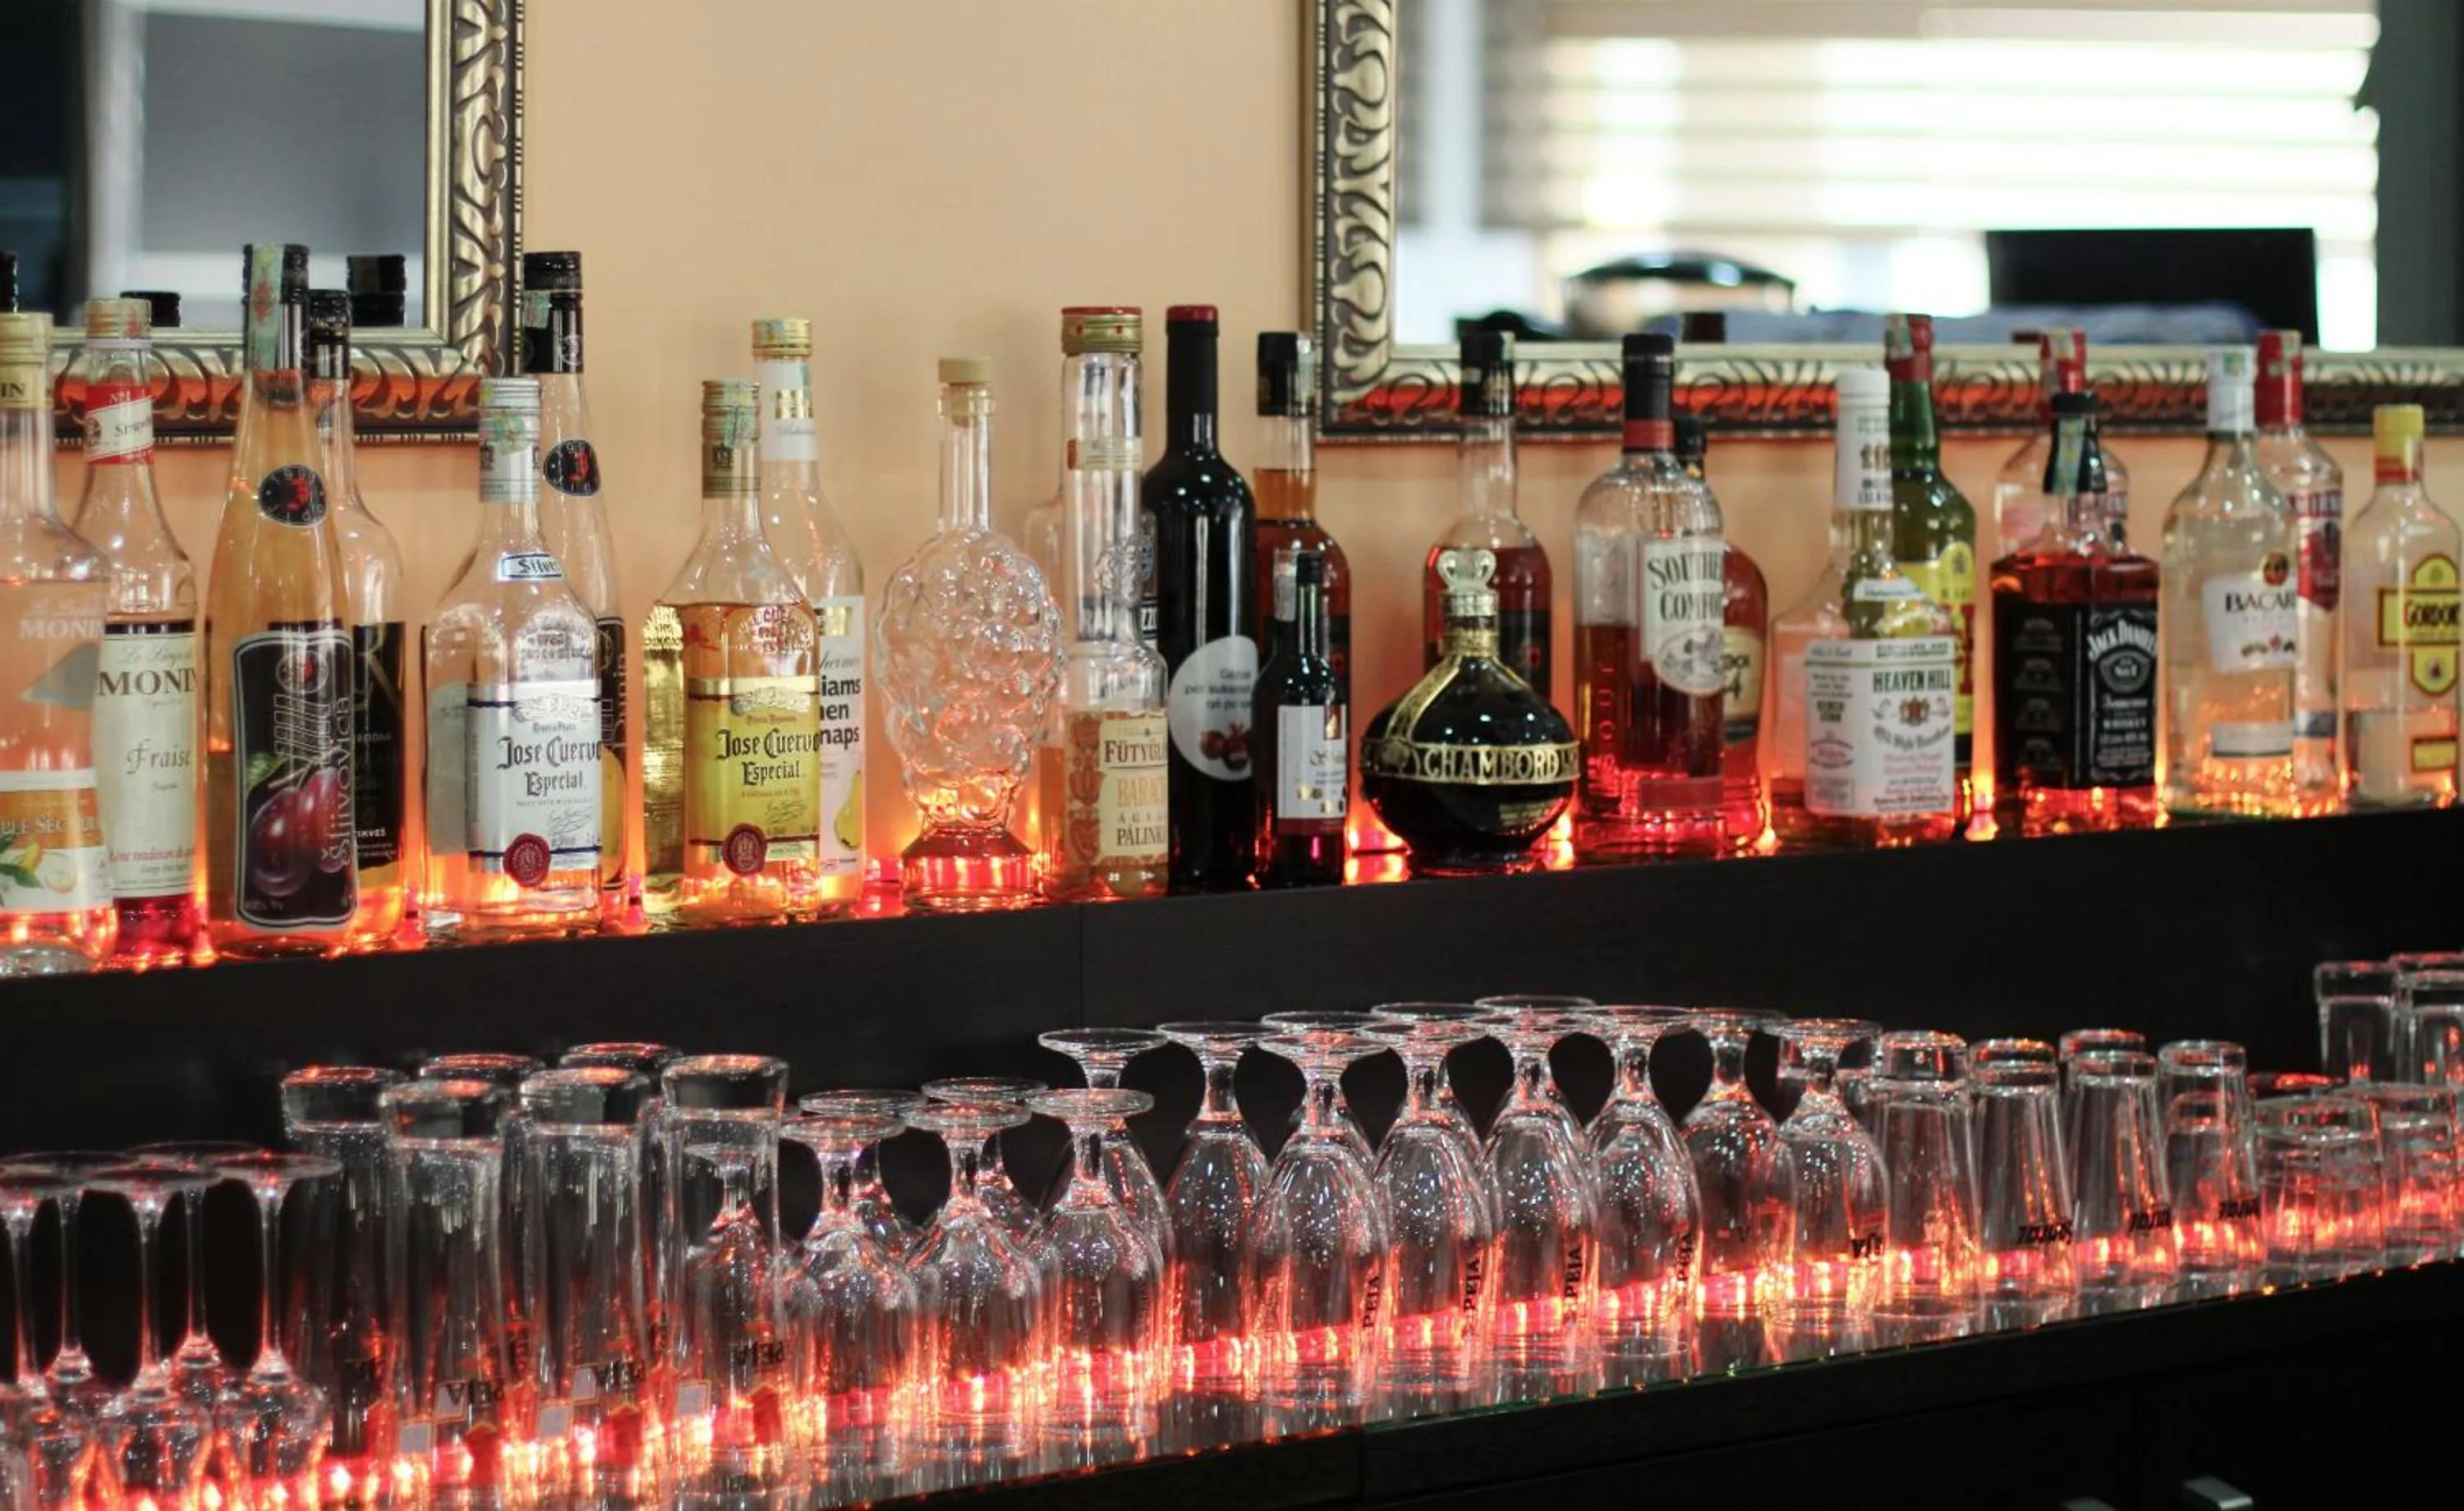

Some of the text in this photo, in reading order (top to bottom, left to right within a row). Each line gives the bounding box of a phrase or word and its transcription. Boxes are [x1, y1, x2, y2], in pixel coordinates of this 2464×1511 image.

[1873, 669, 1924, 694] HEAVEN
[1927, 668, 1951, 691] HILL
[496, 736, 543, 770] Jose
[716, 728, 760, 760] Jose
[742, 760, 799, 787] Especial
[1423, 748, 1560, 779] CHAMBORD
[525, 769, 582, 797] Especial
